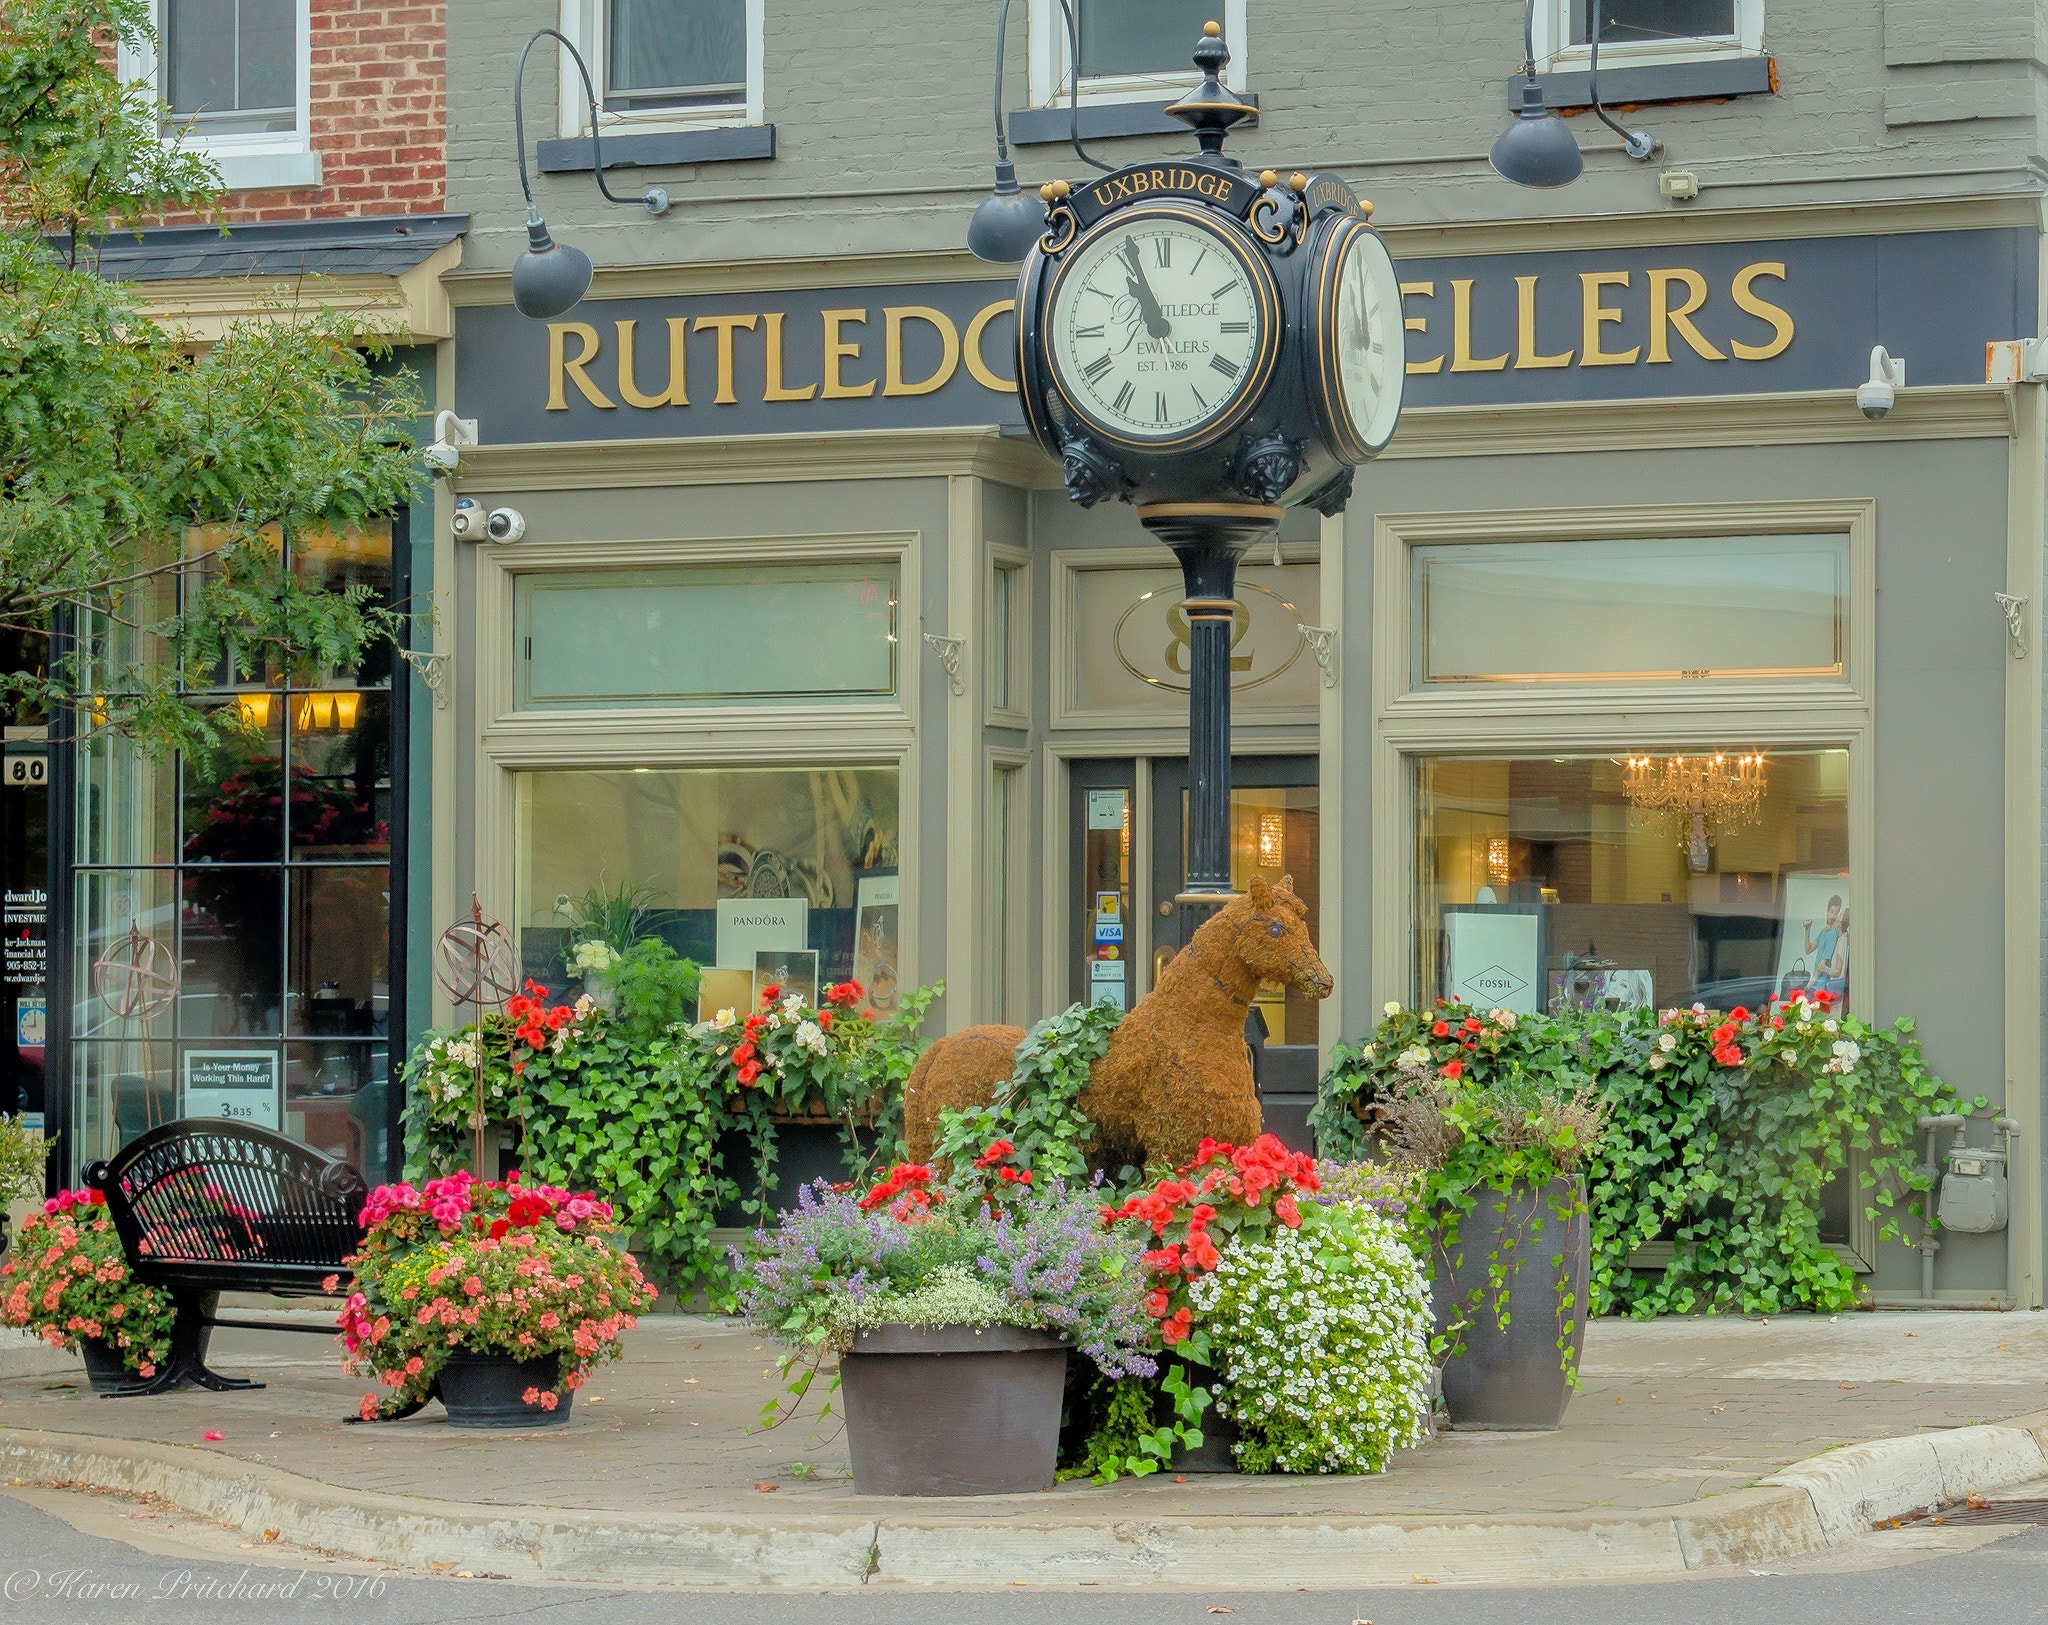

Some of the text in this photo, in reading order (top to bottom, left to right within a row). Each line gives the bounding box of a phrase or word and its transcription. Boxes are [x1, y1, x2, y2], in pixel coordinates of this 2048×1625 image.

[1093, 168, 1233, 206] UXBRIDGE
[1155, 237, 1171, 269] XII
[1211, 279, 1239, 300] II
[1110, 292, 1220, 325] RTLEDGE
[1220, 321, 1250, 335] III
[1137, 360, 1188, 372] EST. 1986
[13, 760, 44, 781] 80
[733, 915, 786, 926] PANDORA
[1098, 927, 1122, 937] VISA
[1479, 980, 1512, 988] FOSSIL
[203, 1063, 260, 1073] Is Your Money
[192, 1074, 270, 1084] Working This Hard?
[221, 1102, 271, 1117] 3.835 %
